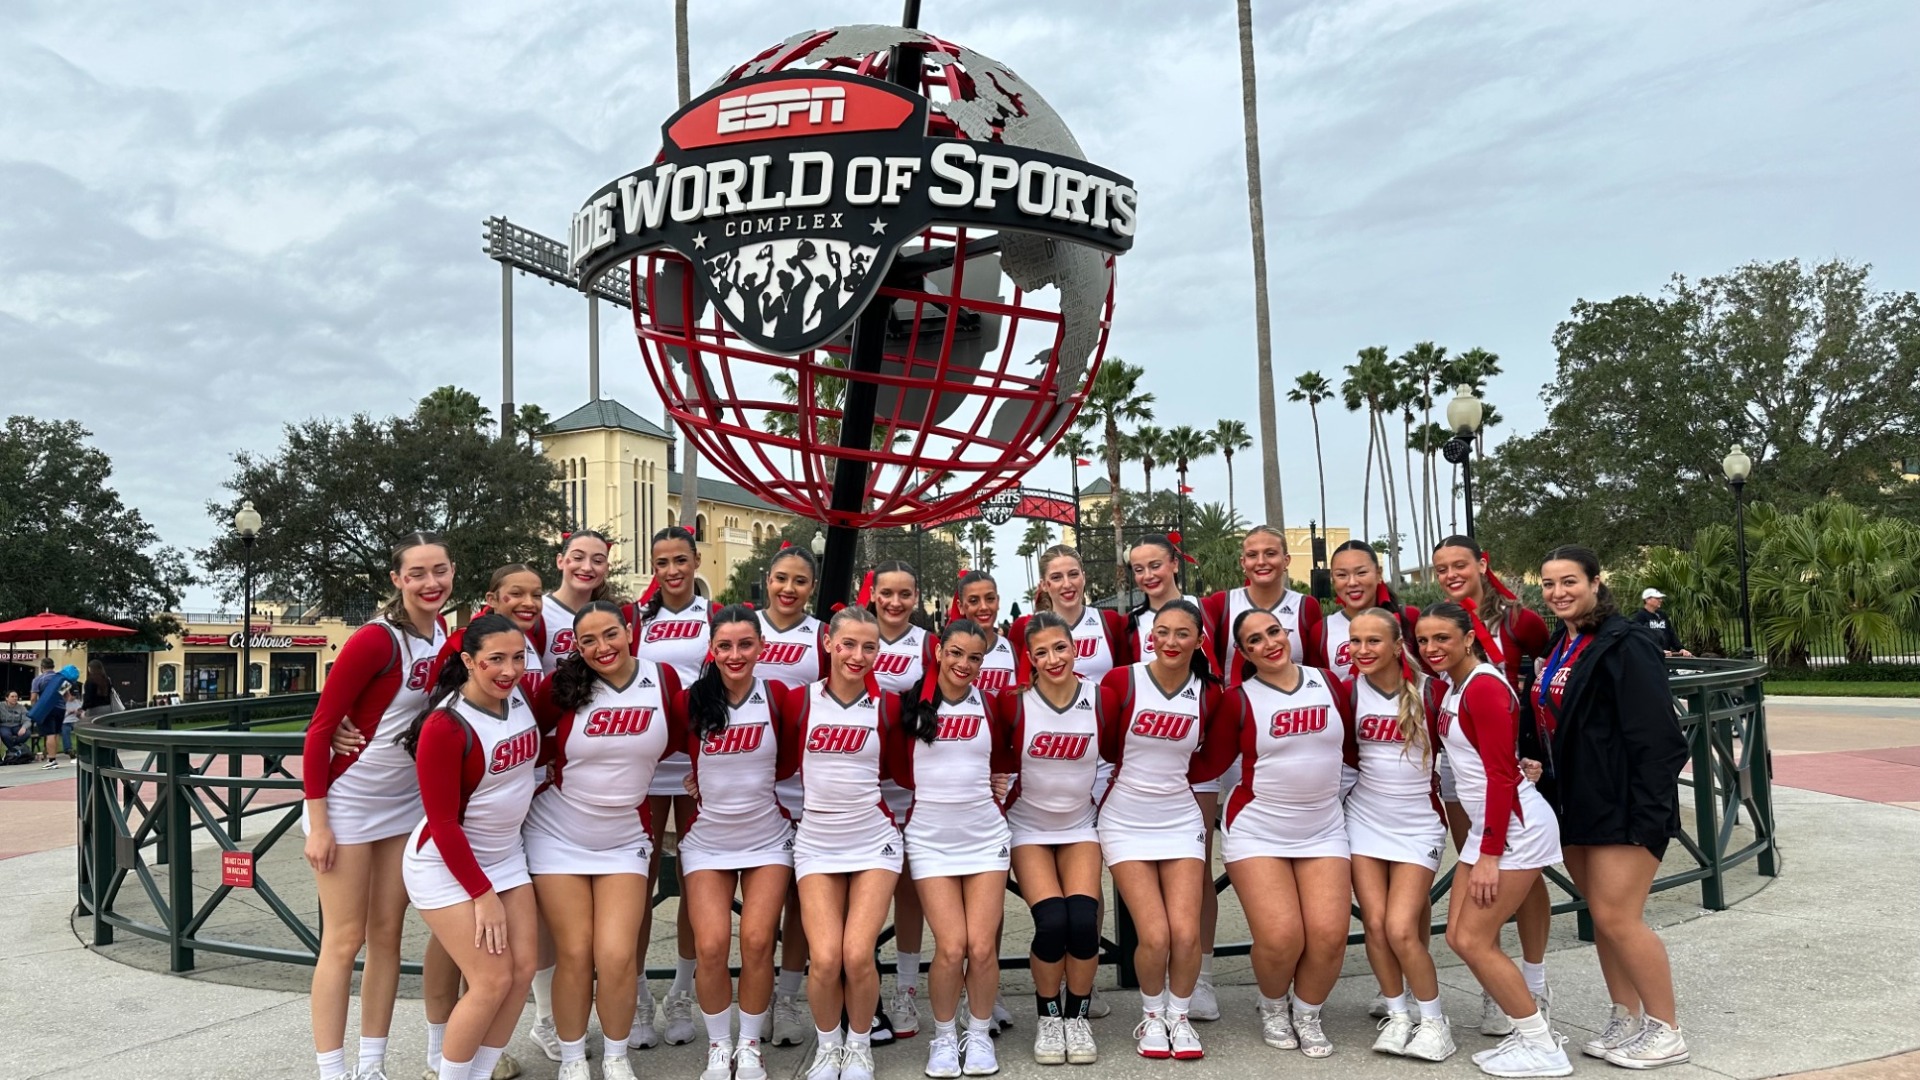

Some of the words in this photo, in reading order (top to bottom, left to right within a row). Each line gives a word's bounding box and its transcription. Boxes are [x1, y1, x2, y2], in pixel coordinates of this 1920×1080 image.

[717, 86, 846, 134] ESPN
[567, 191, 617, 268] IDE
[617, 151, 835, 235] WORLD
[845, 156, 922, 205] OF
[928, 142, 1138, 238] SPORTS
[725, 212, 844, 237] COMPLEX
[645, 619, 707, 643] SHU
[12, 653, 38, 661] OFFICE
[872, 652, 919, 676] HU
[584, 706, 658, 737] SHU
[1131, 709, 1198, 741] SHU
[1269, 704, 1331, 739] SHU
[489, 725, 539, 775] SHU
[702, 721, 769, 755] SHU
[807, 724, 875, 754] SHU
[1027, 731, 1094, 760] SHU
